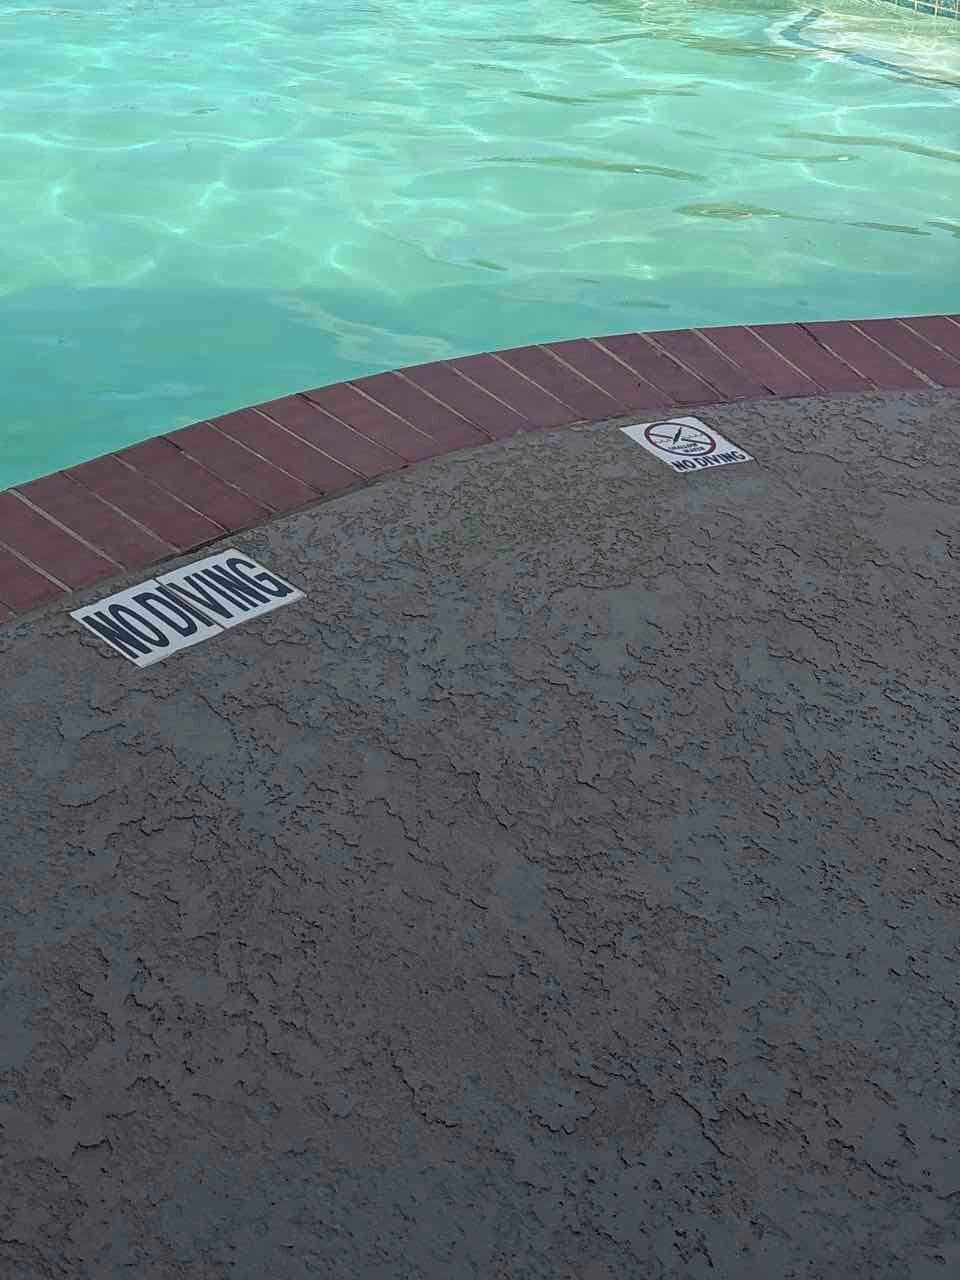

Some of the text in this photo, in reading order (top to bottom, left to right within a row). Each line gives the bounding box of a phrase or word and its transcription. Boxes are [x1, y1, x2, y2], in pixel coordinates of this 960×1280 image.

[671, 451, 746, 471] NO DIVING
[81, 557, 294, 659] NO DIVING
